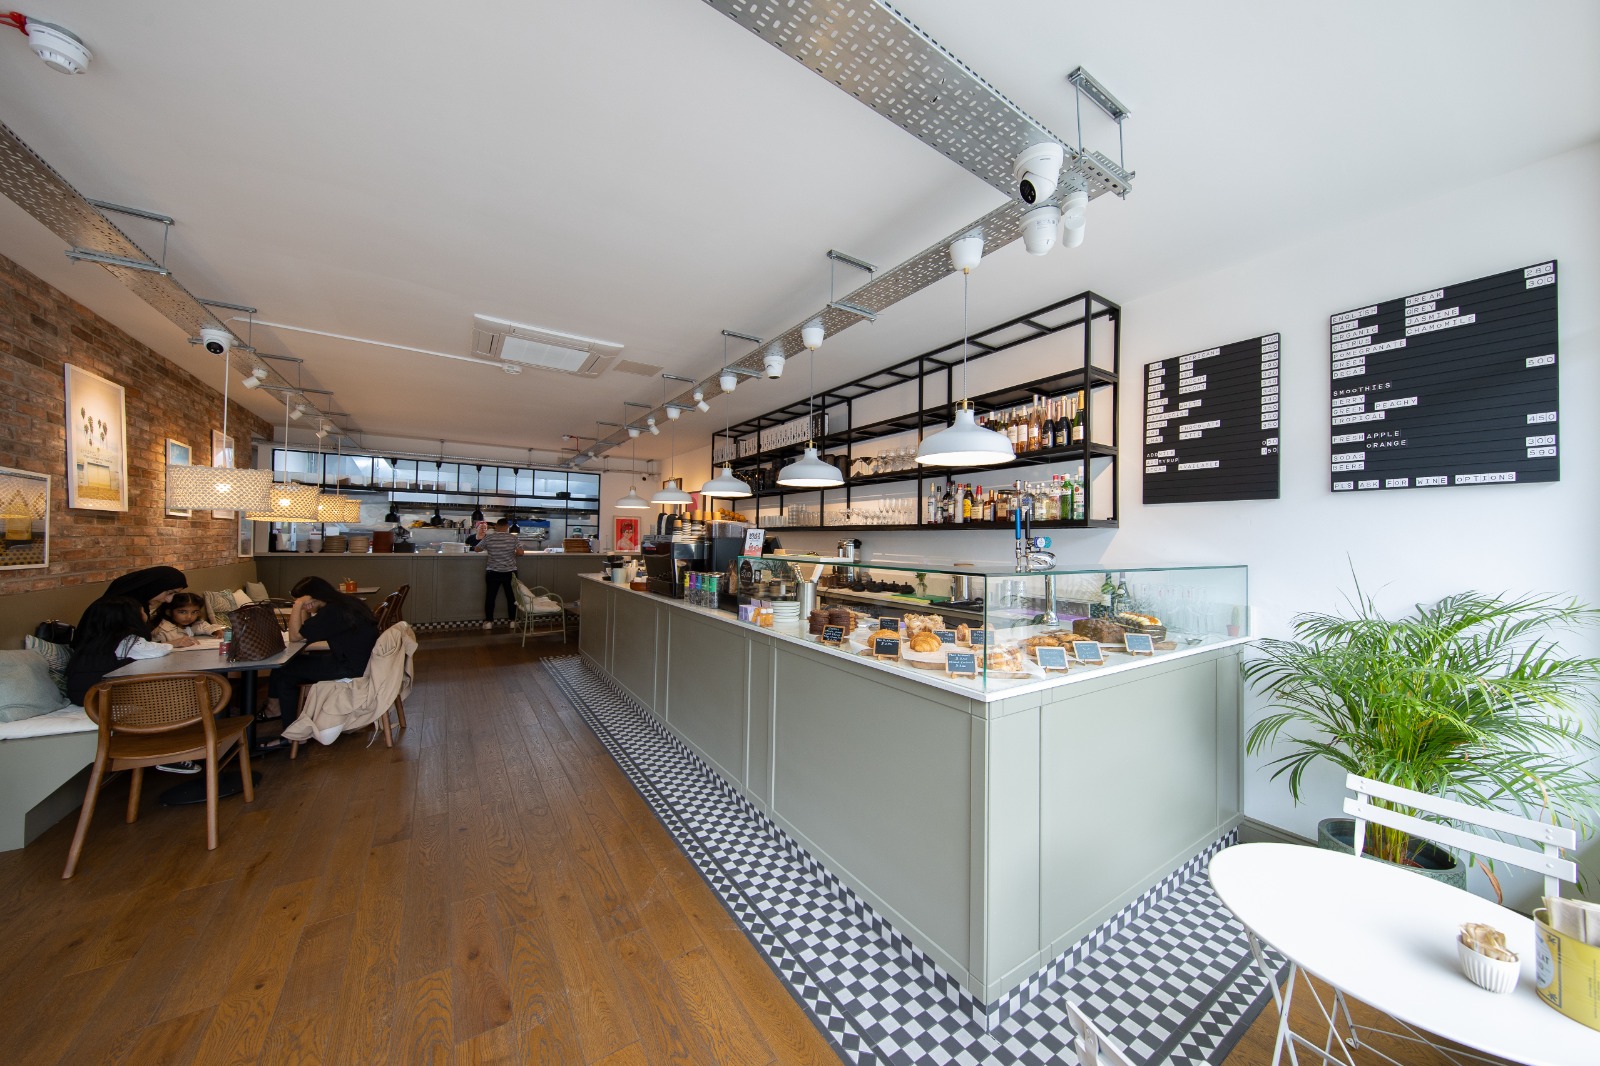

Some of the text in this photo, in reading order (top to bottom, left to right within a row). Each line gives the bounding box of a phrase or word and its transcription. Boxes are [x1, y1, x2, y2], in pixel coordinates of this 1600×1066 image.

[1332, 265, 1552, 323] ENGLISH BREAK 280
[1332, 276, 1554, 332] EARL GREY 300
[1332, 308, 1458, 342] ORGANIC JASMINE
[1332, 315, 1475, 351] CITRUS CHAMOMILE
[1262, 335, 1278, 344] 300
[1333, 340, 1405, 360] POMEGRANATE
[1333, 358, 1365, 369] GREEN
[1332, 356, 1554, 397] SMOOTHIES 500
[1333, 368, 1365, 378] DECAF
[1332, 395, 1364, 406] BERRY
[1332, 398, 1417, 416] GREEN PEACHY
[1333, 412, 1384, 424] TROPICAL
[1333, 413, 1555, 443] FRESH APPLE 450
[1333, 437, 1554, 462] SODAS 300
[1366, 439, 1407, 449] ORANGE
[1332, 463, 1364, 471] BEERS
[1387, 478, 1408, 487] FOR
[1416, 477, 1446, 486] WINE
[1456, 473, 1515, 483] OPTIONS
